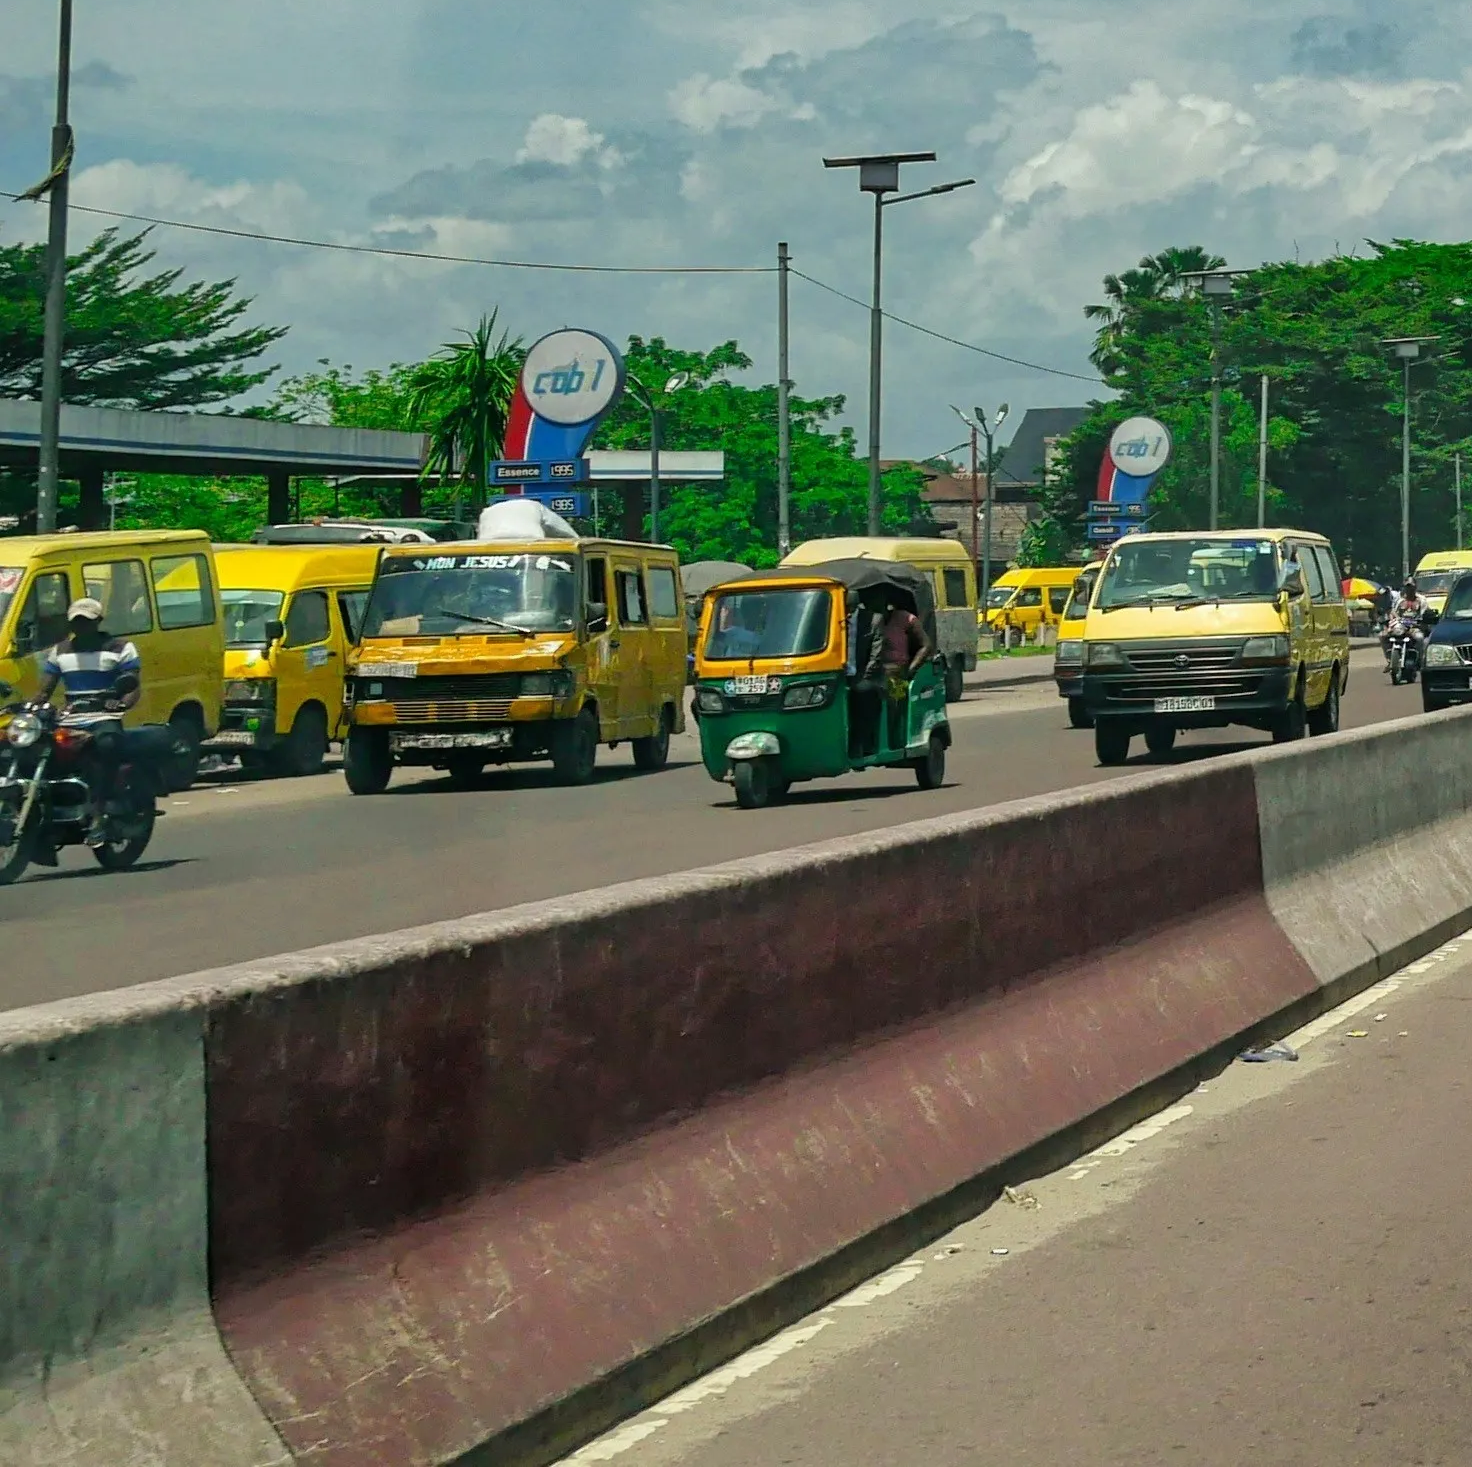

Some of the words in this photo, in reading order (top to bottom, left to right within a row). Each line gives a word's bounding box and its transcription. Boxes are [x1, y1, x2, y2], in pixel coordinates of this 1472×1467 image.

[533, 358, 605, 394] cobl
[498, 466, 540, 477] Essence
[551, 464, 573, 477] 1995
[460, 555, 510, 569] JESUS
